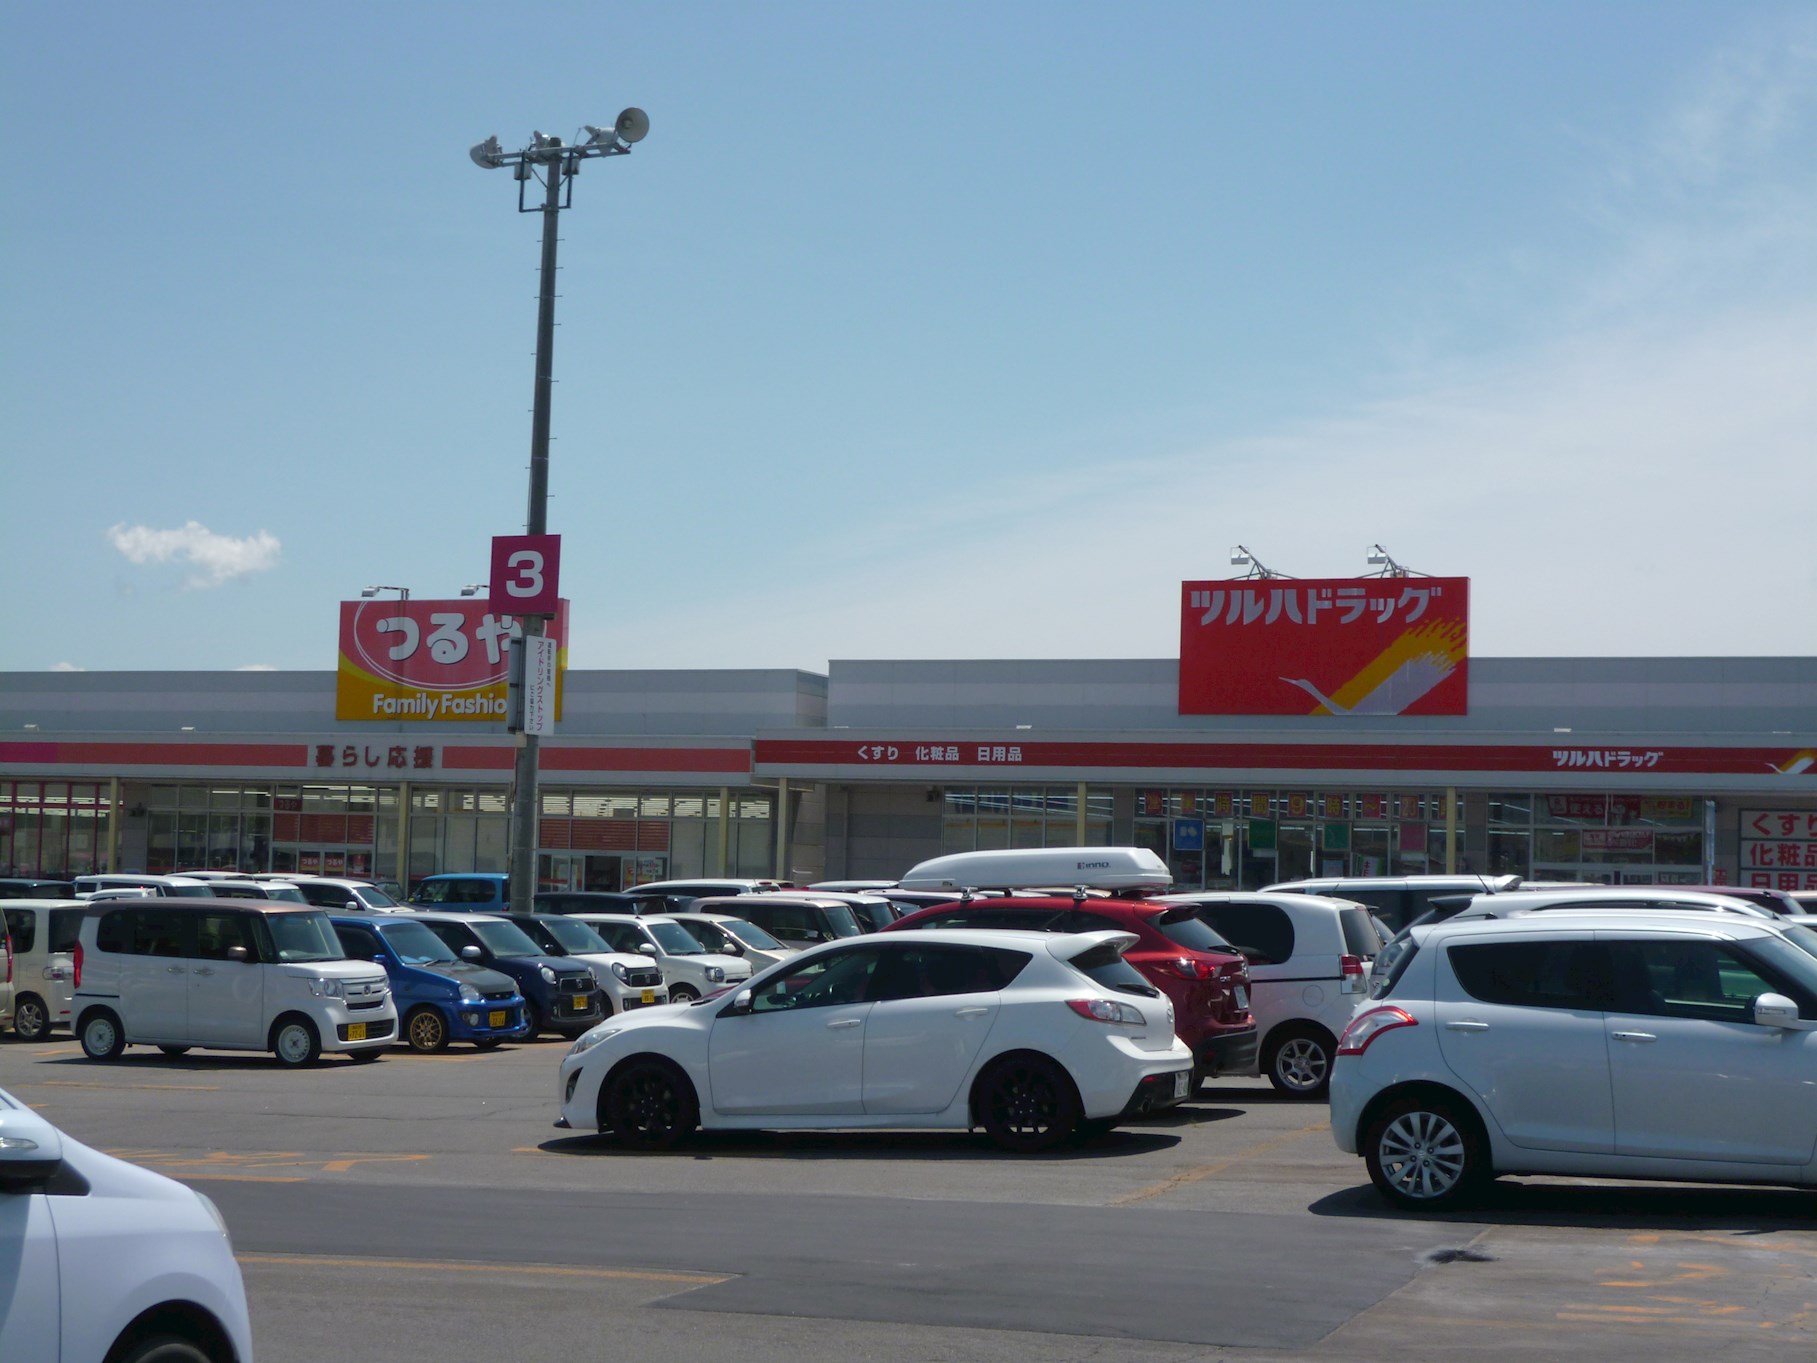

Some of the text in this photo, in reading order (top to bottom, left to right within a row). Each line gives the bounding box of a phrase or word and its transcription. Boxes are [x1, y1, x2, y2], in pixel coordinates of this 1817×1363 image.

[506, 550, 544, 598] 3
[1190, 586, 1441, 626] ツルハドラッグ
[376, 612, 522, 665] つるや
[372, 692, 509, 720] Family Fashio
[316, 744, 435, 769] 暮らし応援
[857, 745, 1023, 762] くすり 化粧品 日用品
[1552, 750, 1664, 768] ツルハドラッグ
